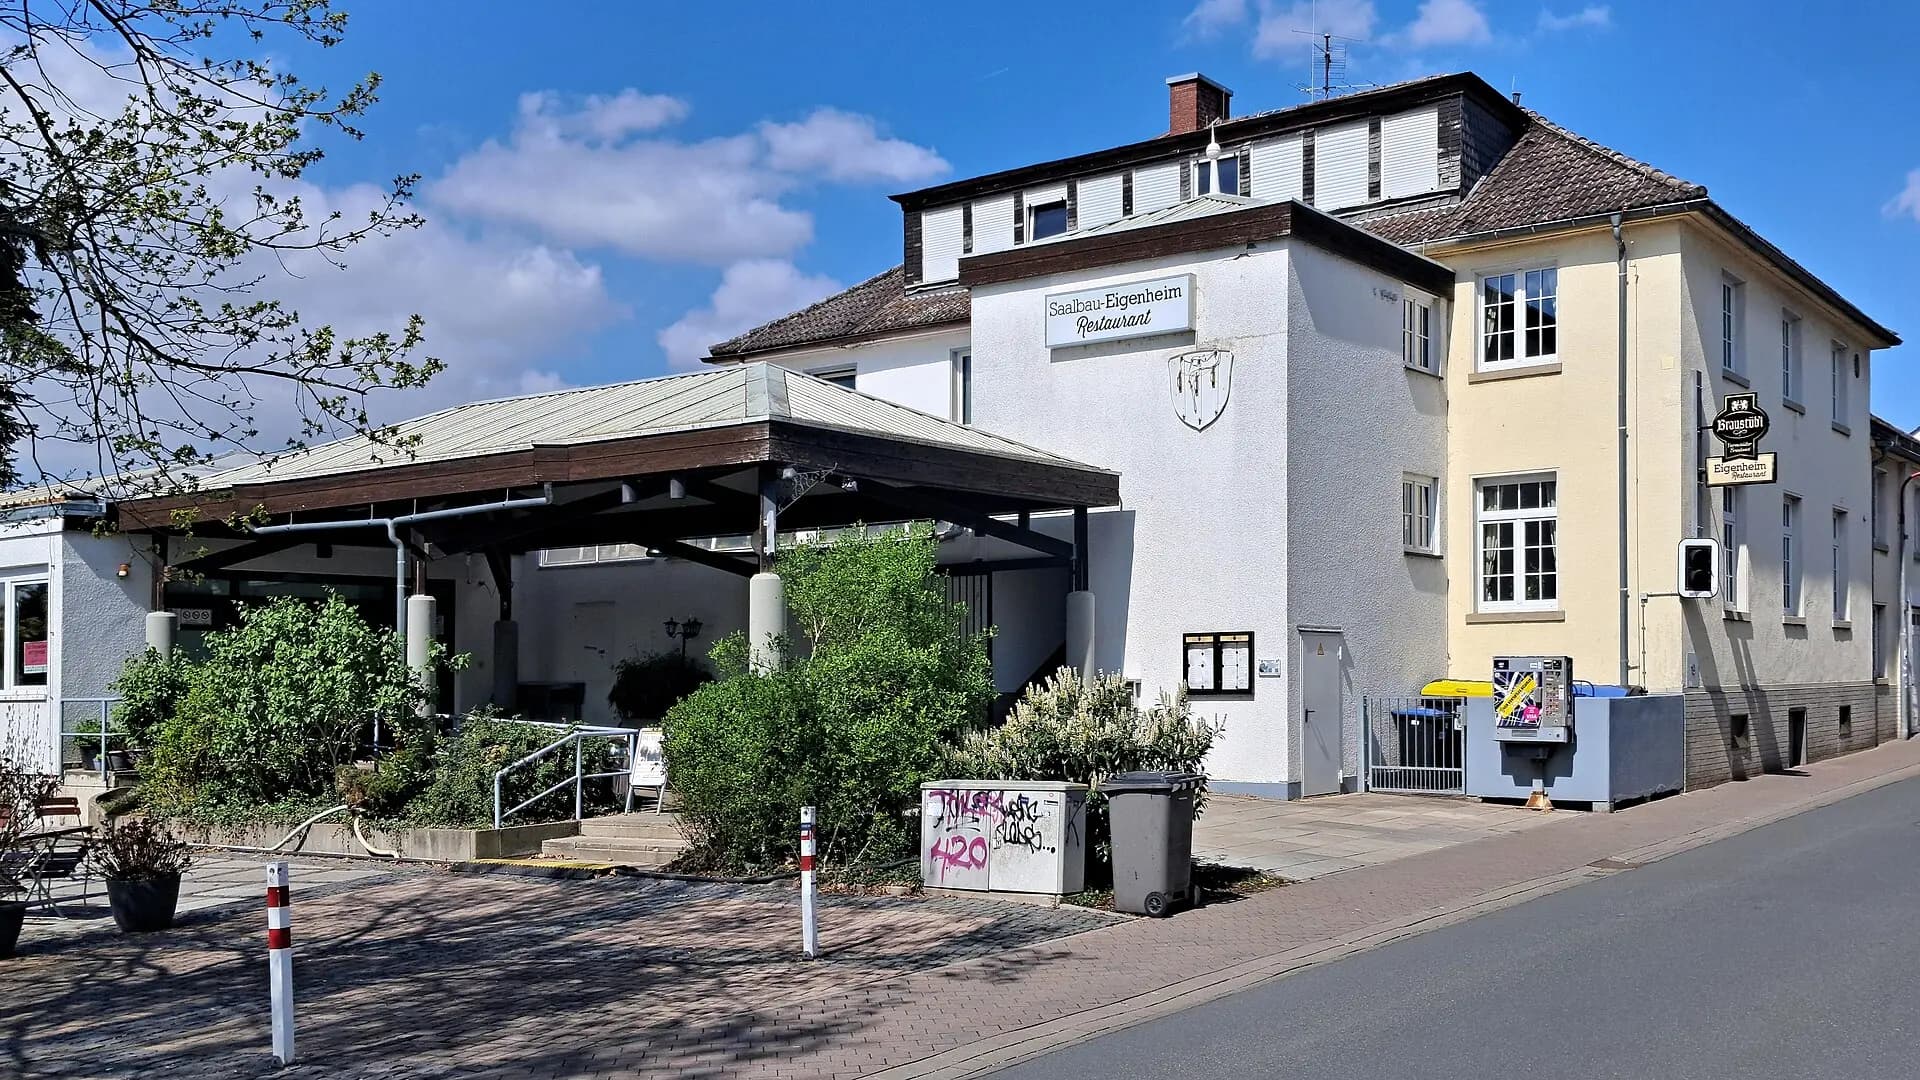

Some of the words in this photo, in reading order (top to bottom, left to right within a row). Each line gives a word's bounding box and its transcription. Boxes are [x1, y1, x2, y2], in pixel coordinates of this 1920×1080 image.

[1049, 285, 1182, 317] Saalbau-Eigenheim
[1076, 309, 1152, 338] Restaurant
[1714, 462, 1767, 474] Eigenheim
[1731, 471, 1767, 480] Restaurant
[930, 835, 987, 883] 420
